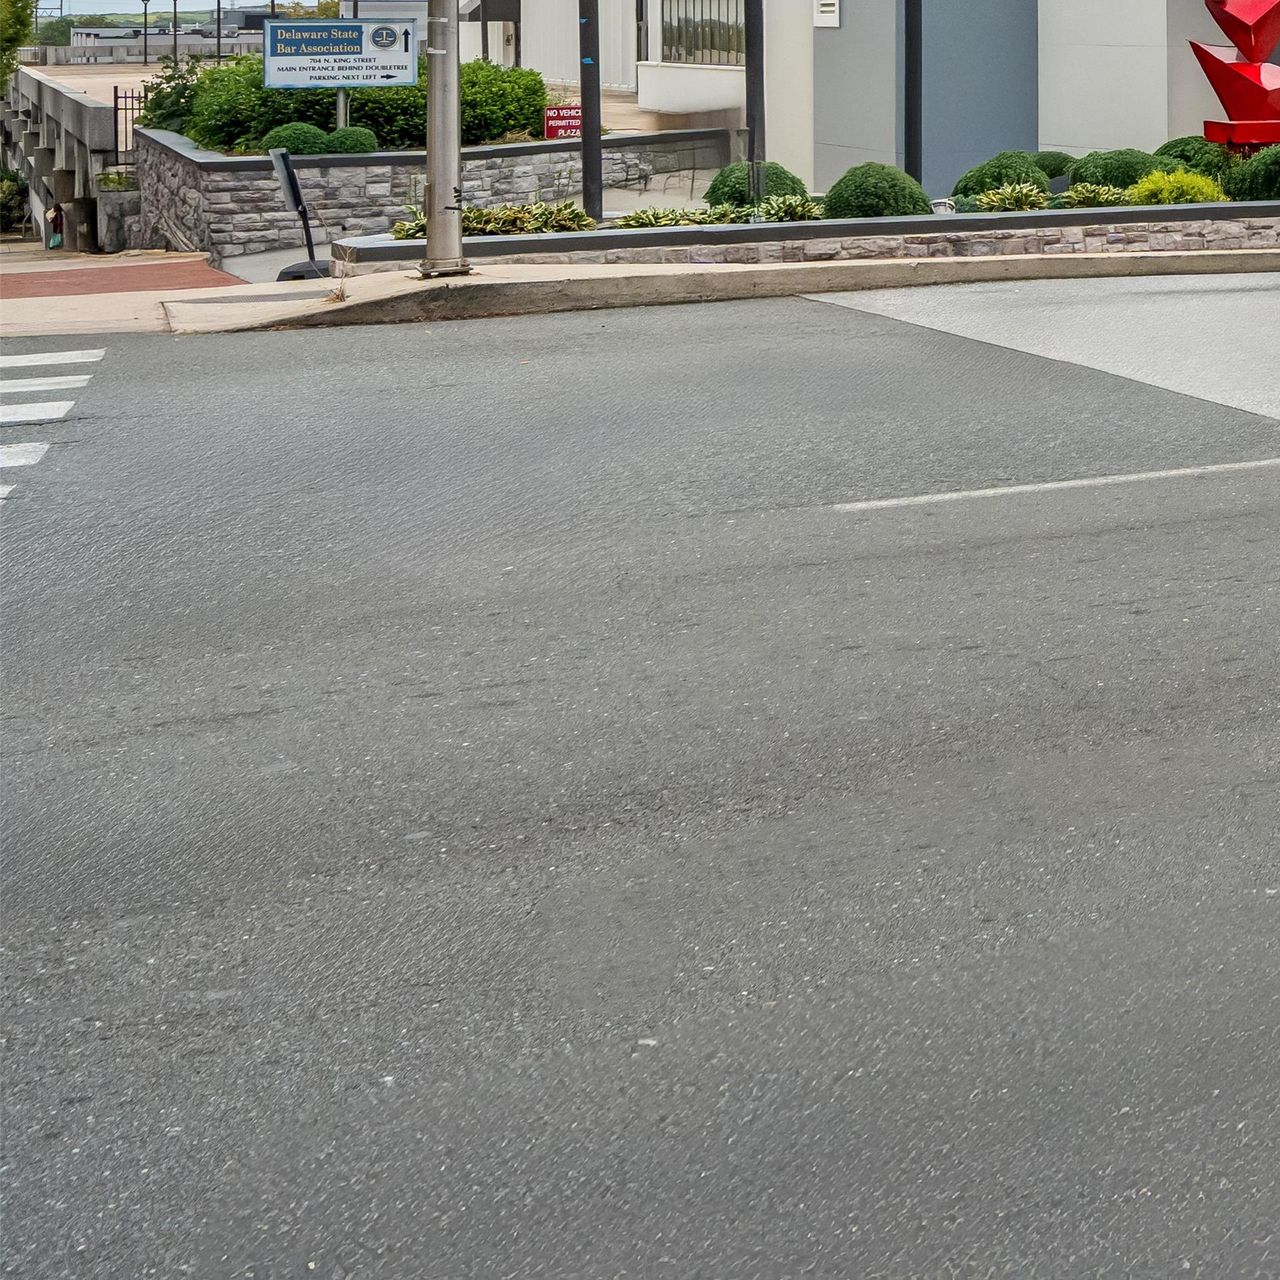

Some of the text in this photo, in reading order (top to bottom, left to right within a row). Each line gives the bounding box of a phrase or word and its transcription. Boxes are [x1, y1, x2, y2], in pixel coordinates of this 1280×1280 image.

[277, 28, 358, 39] Delaware State
[277, 43, 360, 53] Bar Association
